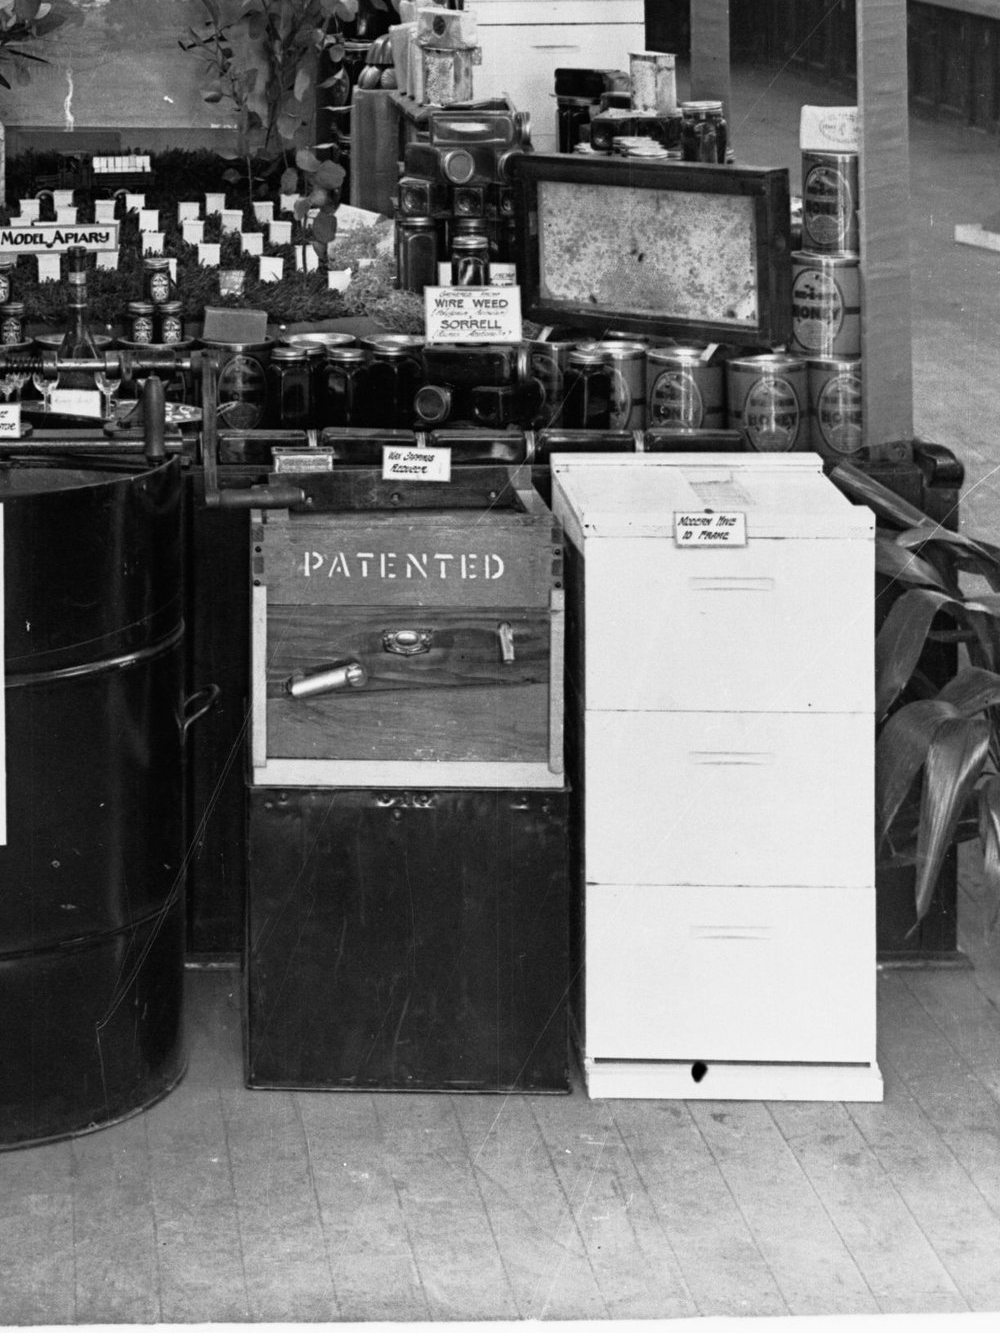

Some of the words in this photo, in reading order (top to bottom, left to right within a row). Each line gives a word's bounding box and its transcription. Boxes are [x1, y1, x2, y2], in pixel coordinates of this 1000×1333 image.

[1, 231, 47, 245] MODEL
[52, 230, 110, 244] APIARY
[434, 299, 464, 308] WIRE
[472, 299, 508, 308] WEED
[440, 319, 502, 329] SORRELL
[678, 516, 712, 527] MODERN
[716, 515, 736, 527] HIVE
[698, 531, 730, 539] FRAME
[304, 551, 504, 579] PATENTED
